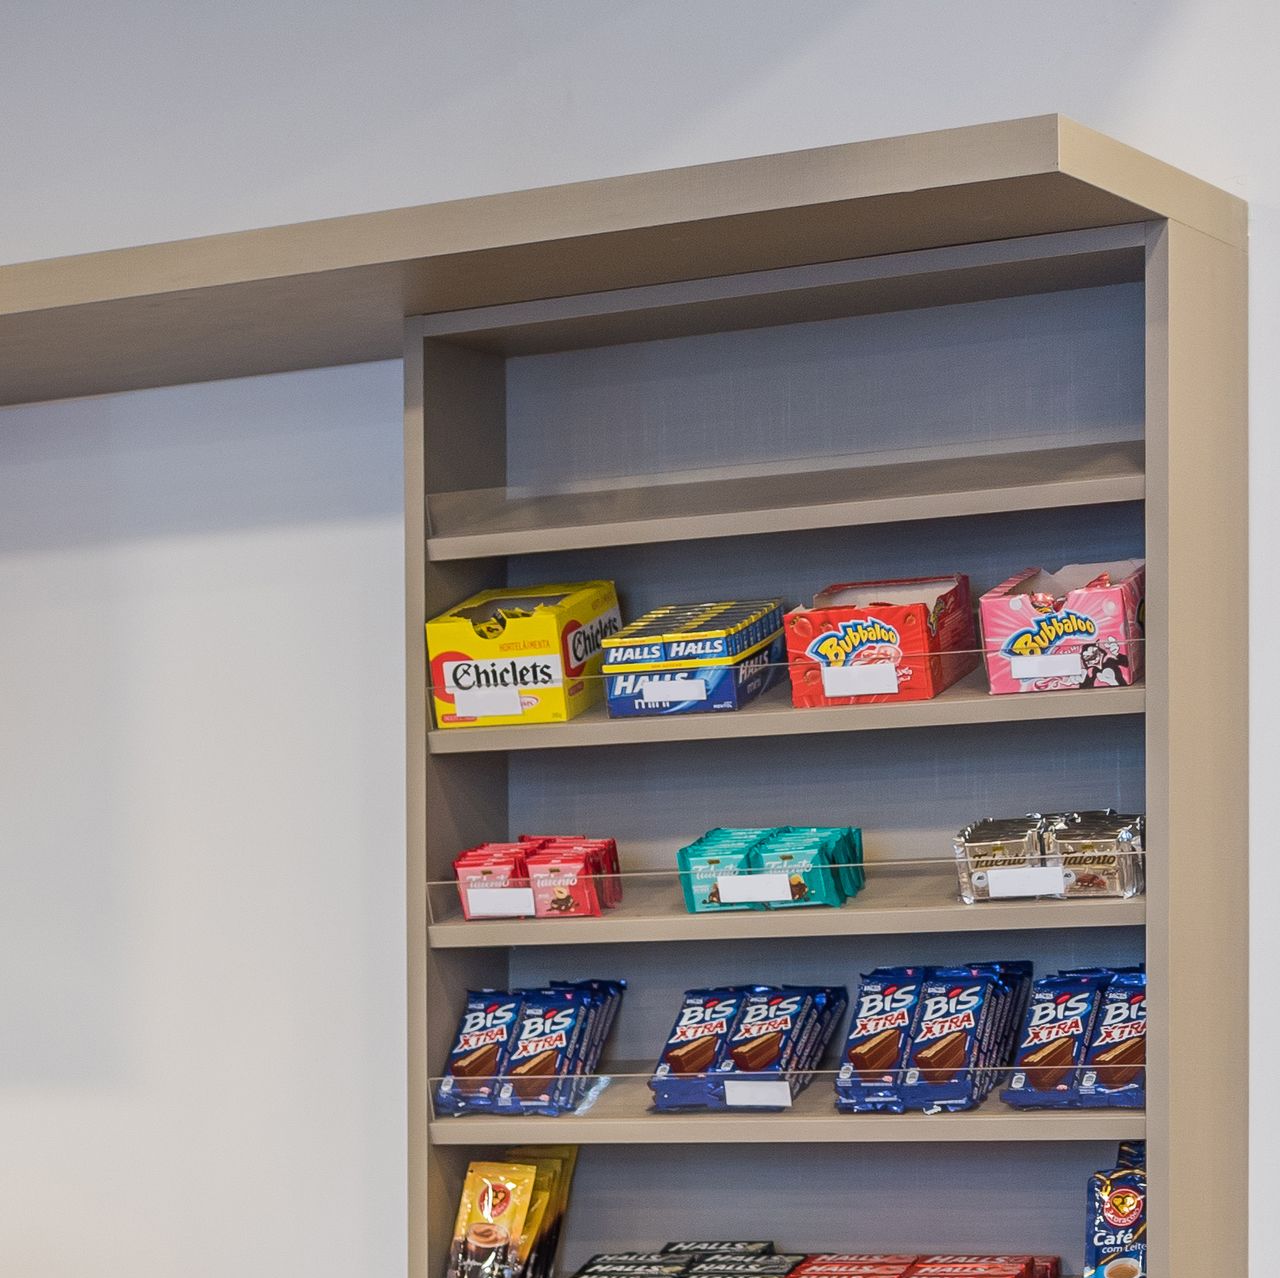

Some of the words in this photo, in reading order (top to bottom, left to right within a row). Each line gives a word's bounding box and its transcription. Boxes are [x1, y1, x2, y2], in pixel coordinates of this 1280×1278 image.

[1011, 615, 1095, 657] Bubbaloo
[608, 645, 661, 663] HALLS
[669, 640, 724, 658] HALLS
[817, 624, 897, 667] Bubbaloo
[453, 661, 553, 691] Chiclets
[1062, 851, 1117, 866] Talento
[671, 1020, 726, 1042] XTRA
[735, 1016, 790, 1040] XTRA
[852, 1009, 908, 1038] XTRA
[917, 1011, 974, 1041] XTRA
[1023, 1018, 1082, 1046] XTRA
[457, 1026, 506, 1052] XTRA
[515, 1033, 564, 1058] XTRA
[1093, 1228, 1133, 1246] Café
[669, 1242, 747, 1251] HALLS
[1102, 1245, 1123, 1254] com
[816, 1254, 881, 1263] HALLS
[927, 1255, 1008, 1264] HALLS
[586, 1264, 664, 1273] HALLS
[693, 1264, 761, 1272] HALLS
[805, 1265, 875, 1273] HALLS
[920, 1266, 991, 1274] HALLS
